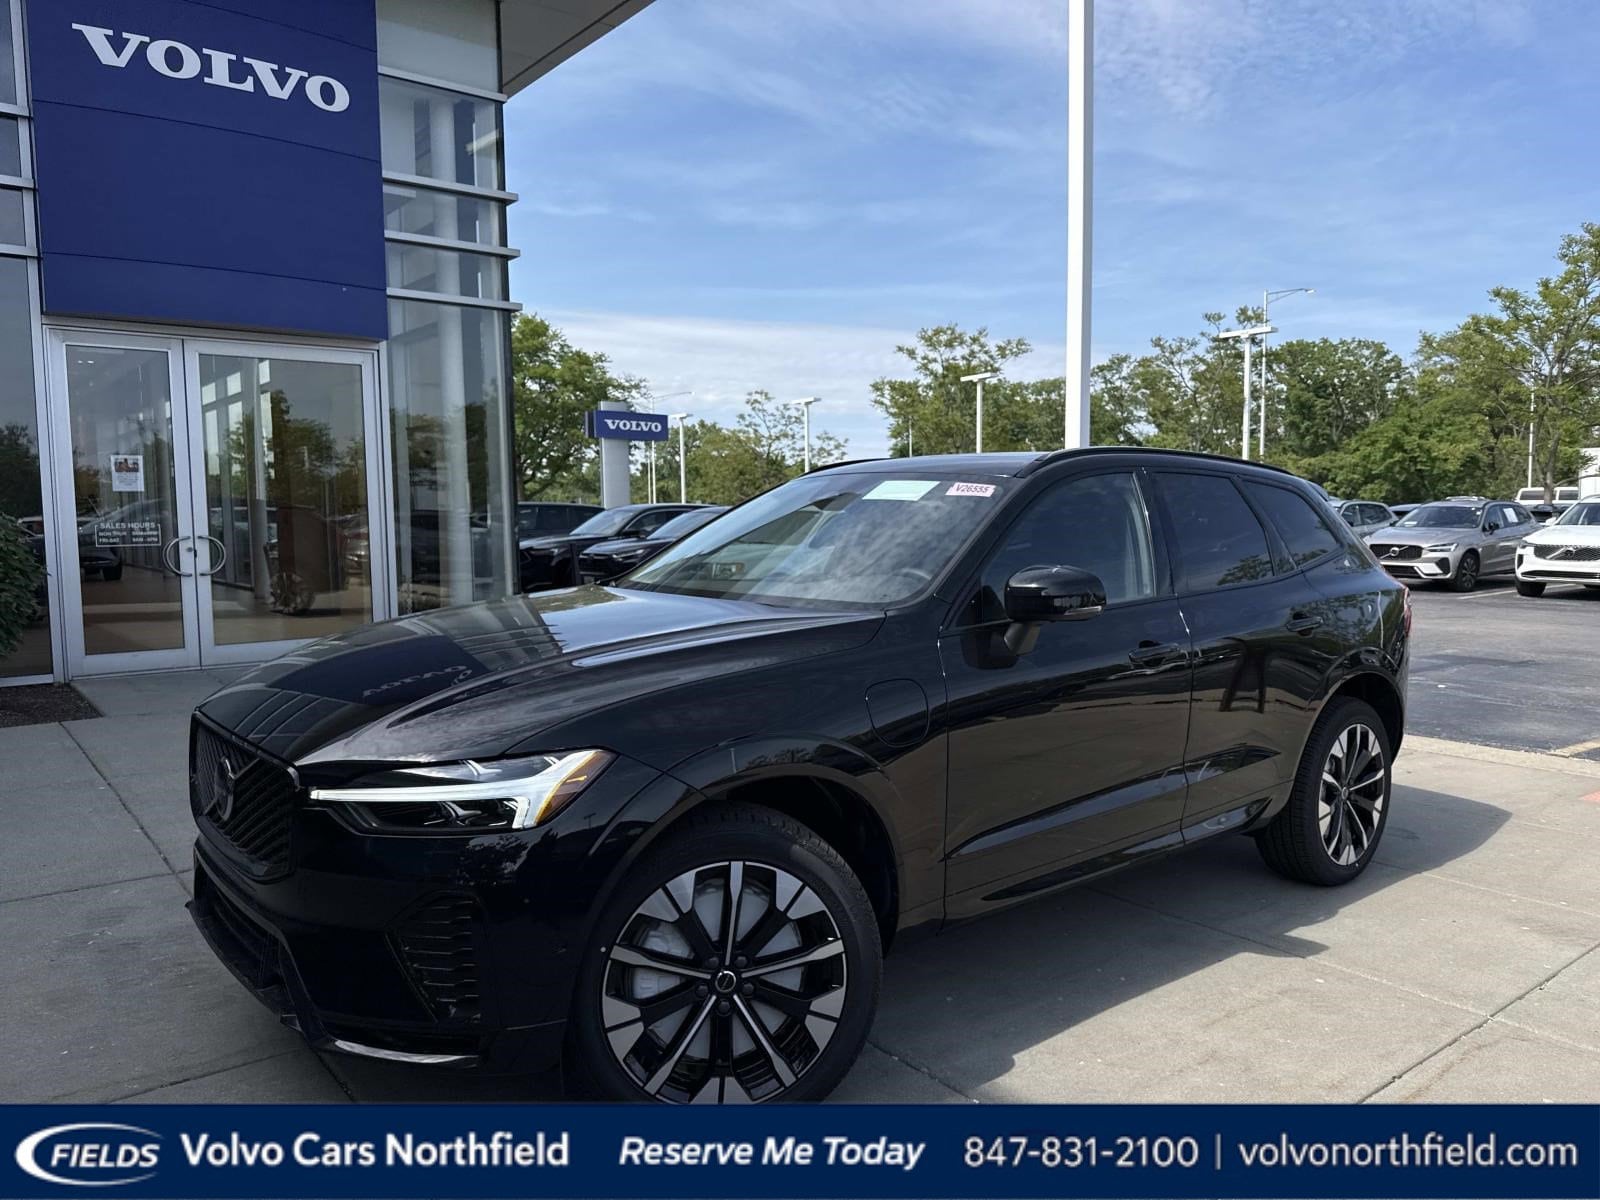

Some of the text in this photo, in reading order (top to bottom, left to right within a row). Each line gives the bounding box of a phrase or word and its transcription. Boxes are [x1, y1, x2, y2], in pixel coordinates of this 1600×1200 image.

[71, 22, 350, 112] VOLVO
[603, 419, 662, 433] VOLVO
[127, 521, 156, 530] HOURS
